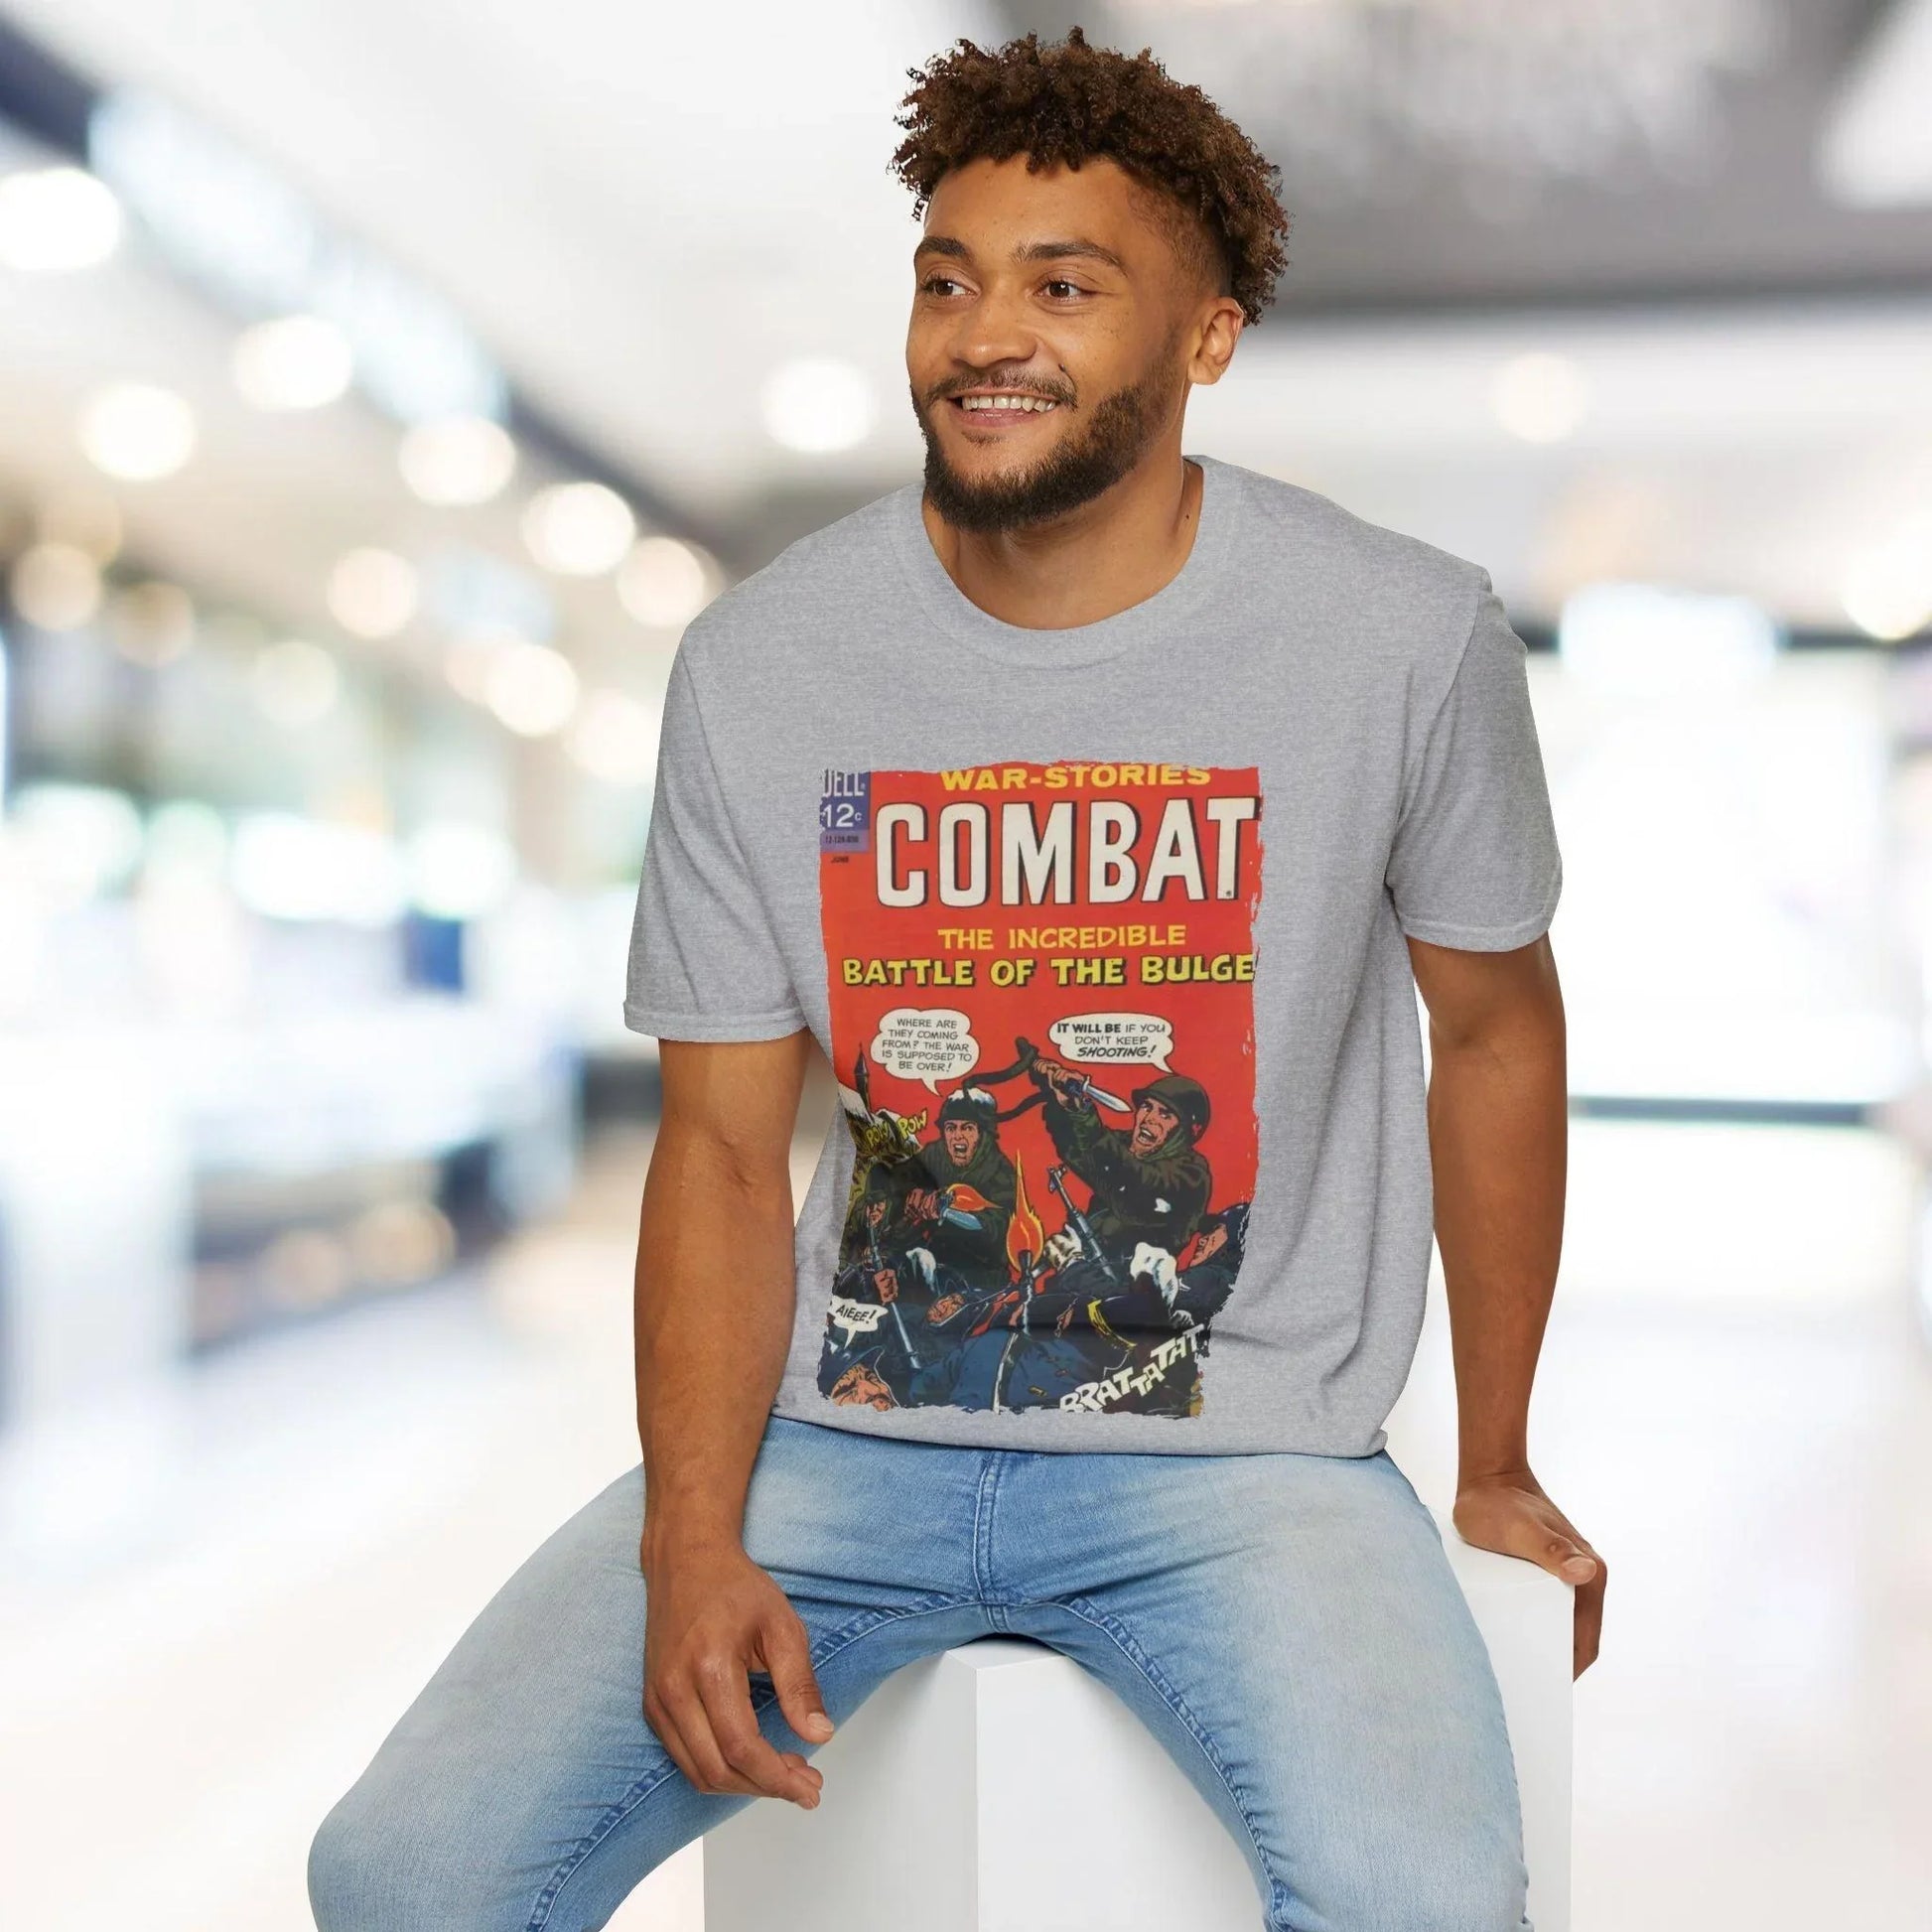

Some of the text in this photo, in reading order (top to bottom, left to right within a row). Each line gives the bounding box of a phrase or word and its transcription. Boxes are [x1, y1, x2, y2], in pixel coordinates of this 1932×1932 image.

[941, 765, 1211, 791] WAR-STORIES
[876, 797, 1261, 907] COMBAT
[937, 924, 1186, 950] THE INCREDIBLE
[841, 946, 1261, 988] BATTLE OF THE BULGE
[897, 1019, 958, 1030] WHERE ARE
[1056, 1023, 1166, 1034] IT WILL BE IF YOU
[888, 1029, 959, 1040] THEY COMING
[1074, 1035, 1149, 1045] DON'T KEEP
[923, 1041, 943, 1050] THE
[945, 1042, 970, 1052] WAR
[1076, 1045, 1157, 1058] SHOOTING!
[882, 1049, 973, 1062] IS SUPPOSED TO
[898, 1060, 953, 1073] BE OVER!
[865, 1108, 928, 1148] POW POW
[835, 1304, 878, 1324] AIEEE!
